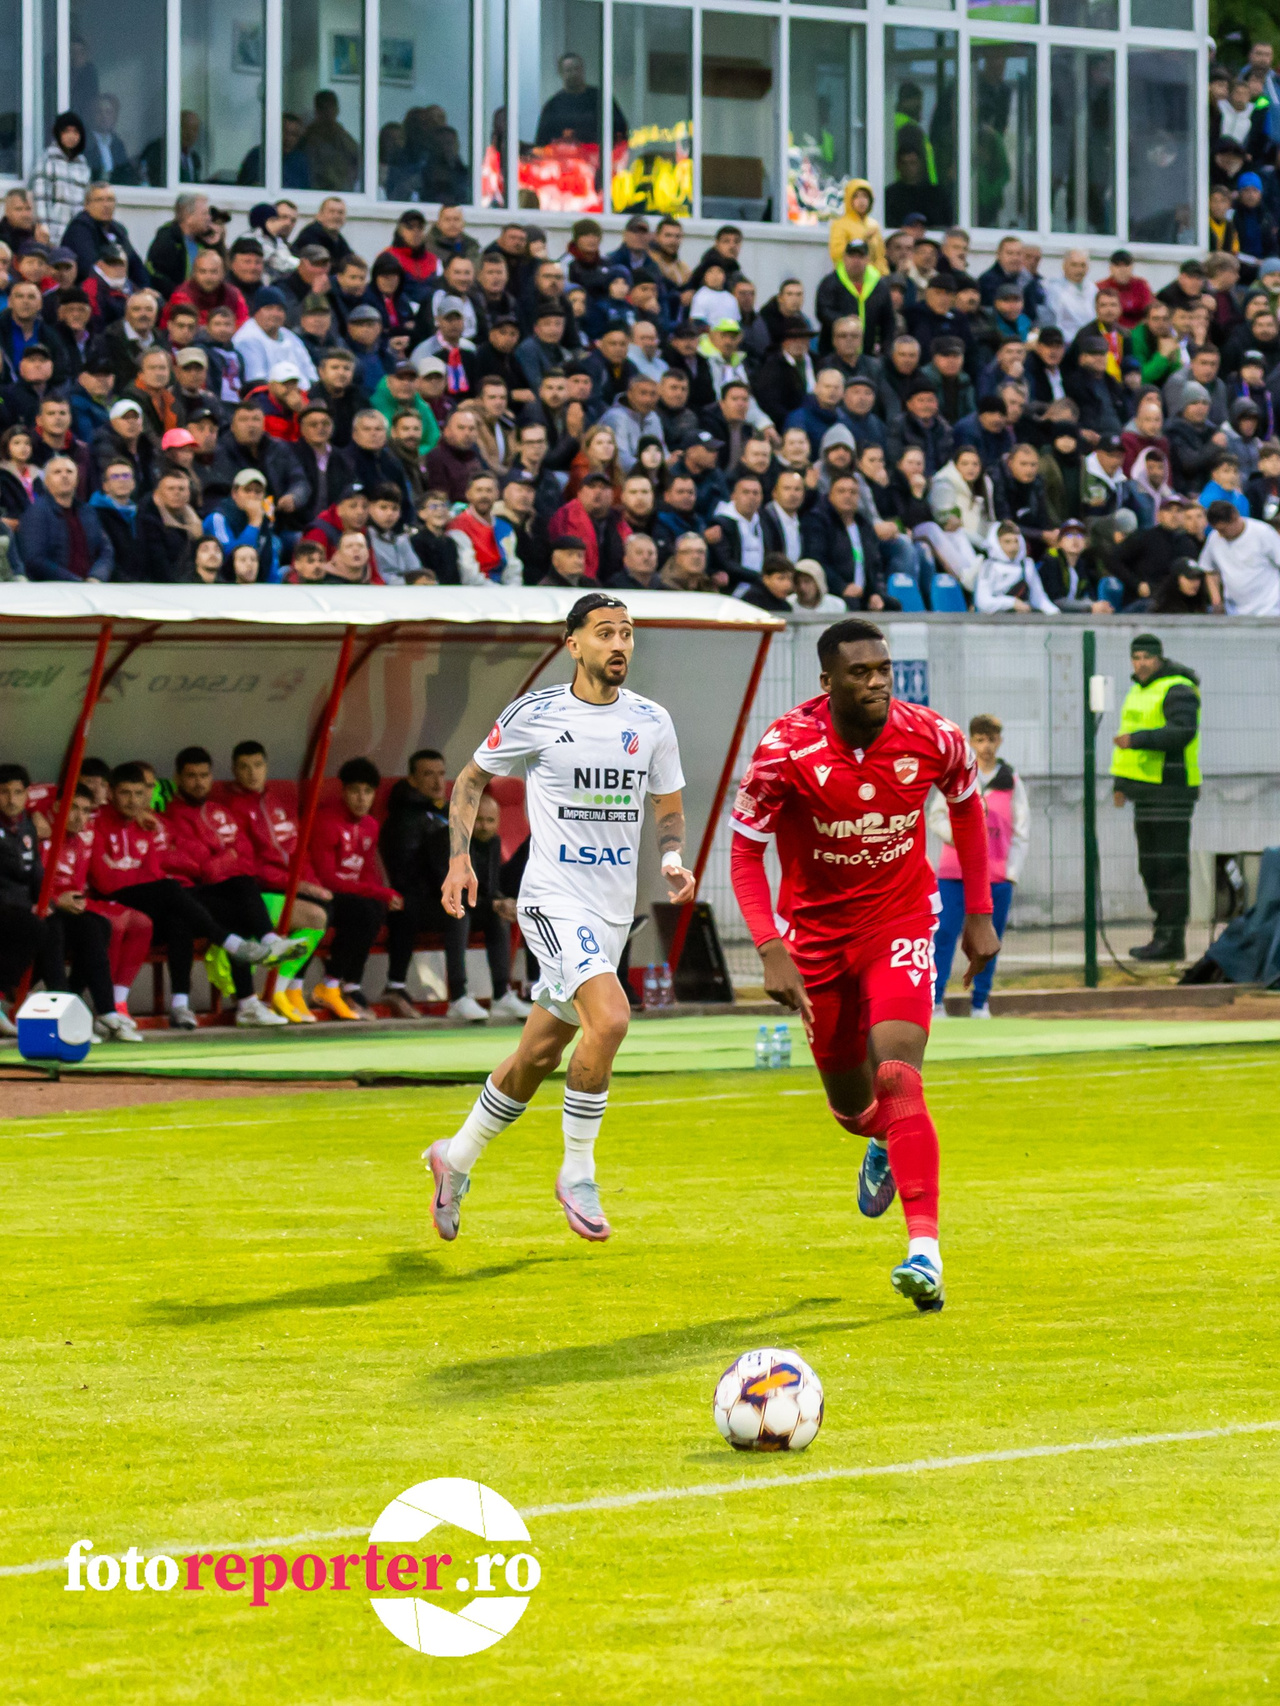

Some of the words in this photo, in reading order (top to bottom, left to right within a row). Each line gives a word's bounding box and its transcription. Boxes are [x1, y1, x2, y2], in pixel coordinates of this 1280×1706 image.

[812, 809, 922, 839] WIN2.RO
[576, 925, 600, 955] 8
[889, 937, 930, 970] 28
